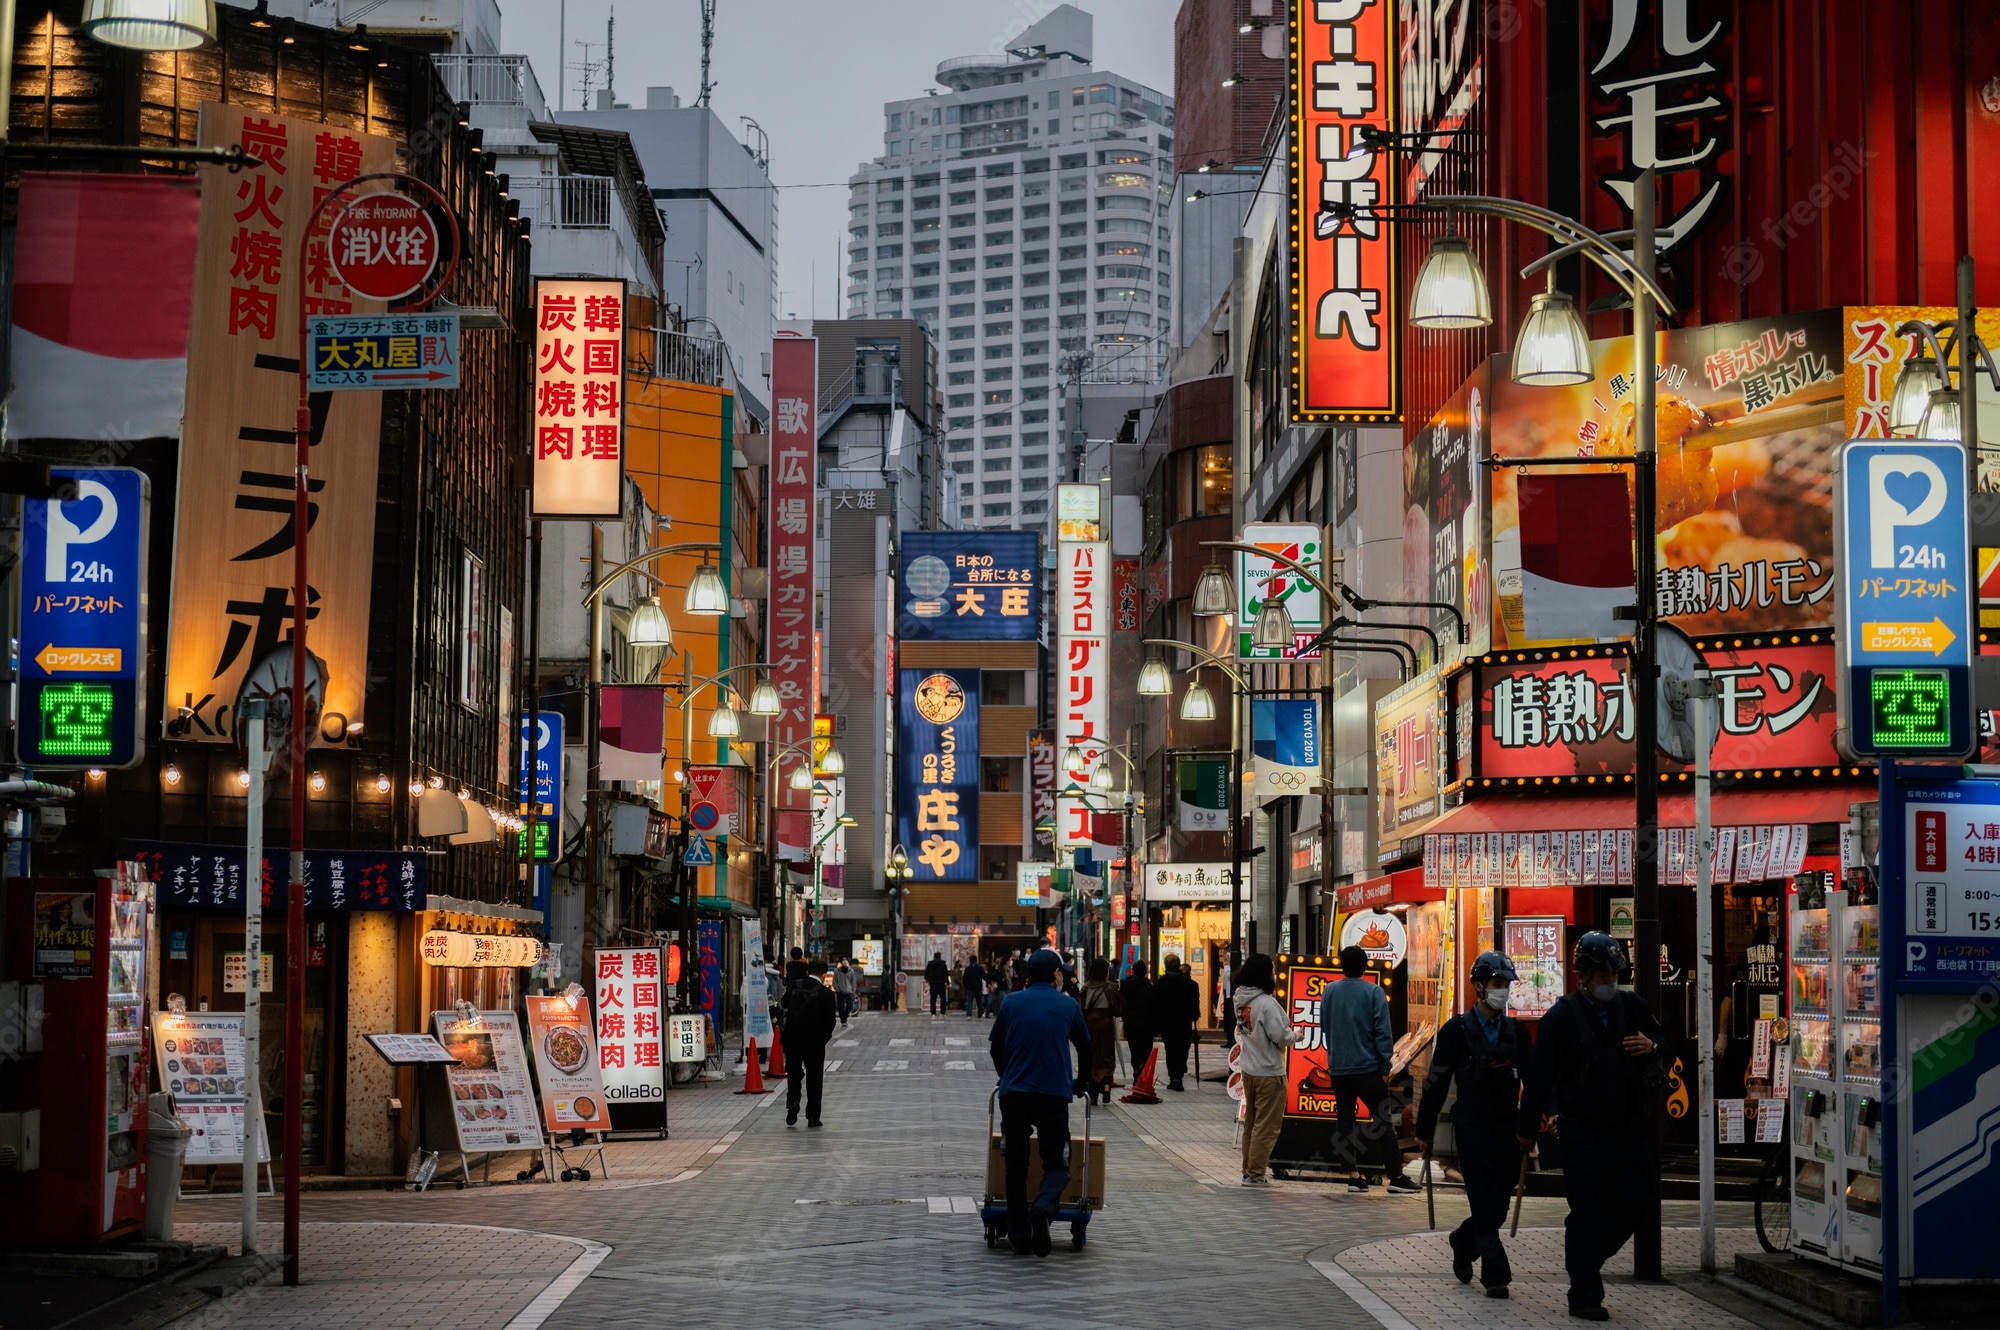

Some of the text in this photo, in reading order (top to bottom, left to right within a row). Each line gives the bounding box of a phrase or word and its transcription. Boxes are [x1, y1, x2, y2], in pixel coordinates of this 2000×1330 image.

[1313, 0, 1380, 349] ーキリバーベ
[349, 207, 418, 219] FIRE HYDRANT
[228, 116, 289, 340] 炭火焼肉
[341, 227, 428, 266] 消火栓
[315, 319, 452, 335] 金・プラチナ・宝石・時計
[319, 336, 453, 369] 大丸屋 買入
[1704, 329, 1807, 389] 情ホルで
[315, 372, 367, 384] ここ入る
[538, 295, 576, 461] 炭火焼肉
[582, 295, 621, 461] 韓国料理
[835, 490, 877, 510] 大雄
[1435, 519, 1457, 573] EXTRA
[1899, 545, 1946, 569] 24h
[71, 561, 114, 583] 24h
[955, 555, 993, 567] 日本の
[968, 569, 1032, 582] 台所になる
[1073, 547, 1094, 632] パチスロ
[1436, 566, 1457, 617] COLD
[1859, 577, 1957, 598] パークネット
[33, 594, 124, 614] パークネット
[956, 588, 1030, 617] 大庄
[1872, 637, 1933, 648] ロックレス式
[1878, 626, 1926, 635] 駐車しやすい
[46, 653, 115, 666] ロックレス式
[39, 683, 114, 756] 空
[1493, 662, 1822, 748] 情熱ホモン
[1871, 670, 1951, 744] 空
[1302, 706, 1314, 763] TOKYO 2020
[923, 754, 938, 784] の里
[941, 727, 955, 784] くつろぎ
[695, 774, 715, 782] 止まれ
[1907, 790, 1961, 799] 監視カメラ作動中
[916, 788, 960, 877] 庄や
[1925, 817, 1936, 865] 最大料金
[1964, 846, 2000, 864] 4時
[173, 865, 188, 895] チキン
[187, 855, 201, 904] ヤンニョム
[330, 859, 346, 909] 純豆腐チゲ
[1175, 867, 1250, 886] 寿司 魚がし日一
[1926, 887, 1936, 929] 通常料金
[35, 928, 95, 947] 男性募集
[424, 936, 435, 958] 焼肉
[436, 936, 448, 958] 炭火
[1545, 926, 1558, 971] もつ鍋
[1937, 945, 1990, 957] パークネット
[1758, 944, 1775, 964] 情熱
[1913, 964, 1926, 972] 24h
[598, 953, 626, 1070] 炭火焼肉
[631, 952, 660, 1069] 韓国料理
[603, 1084, 662, 1100] KollaBo
